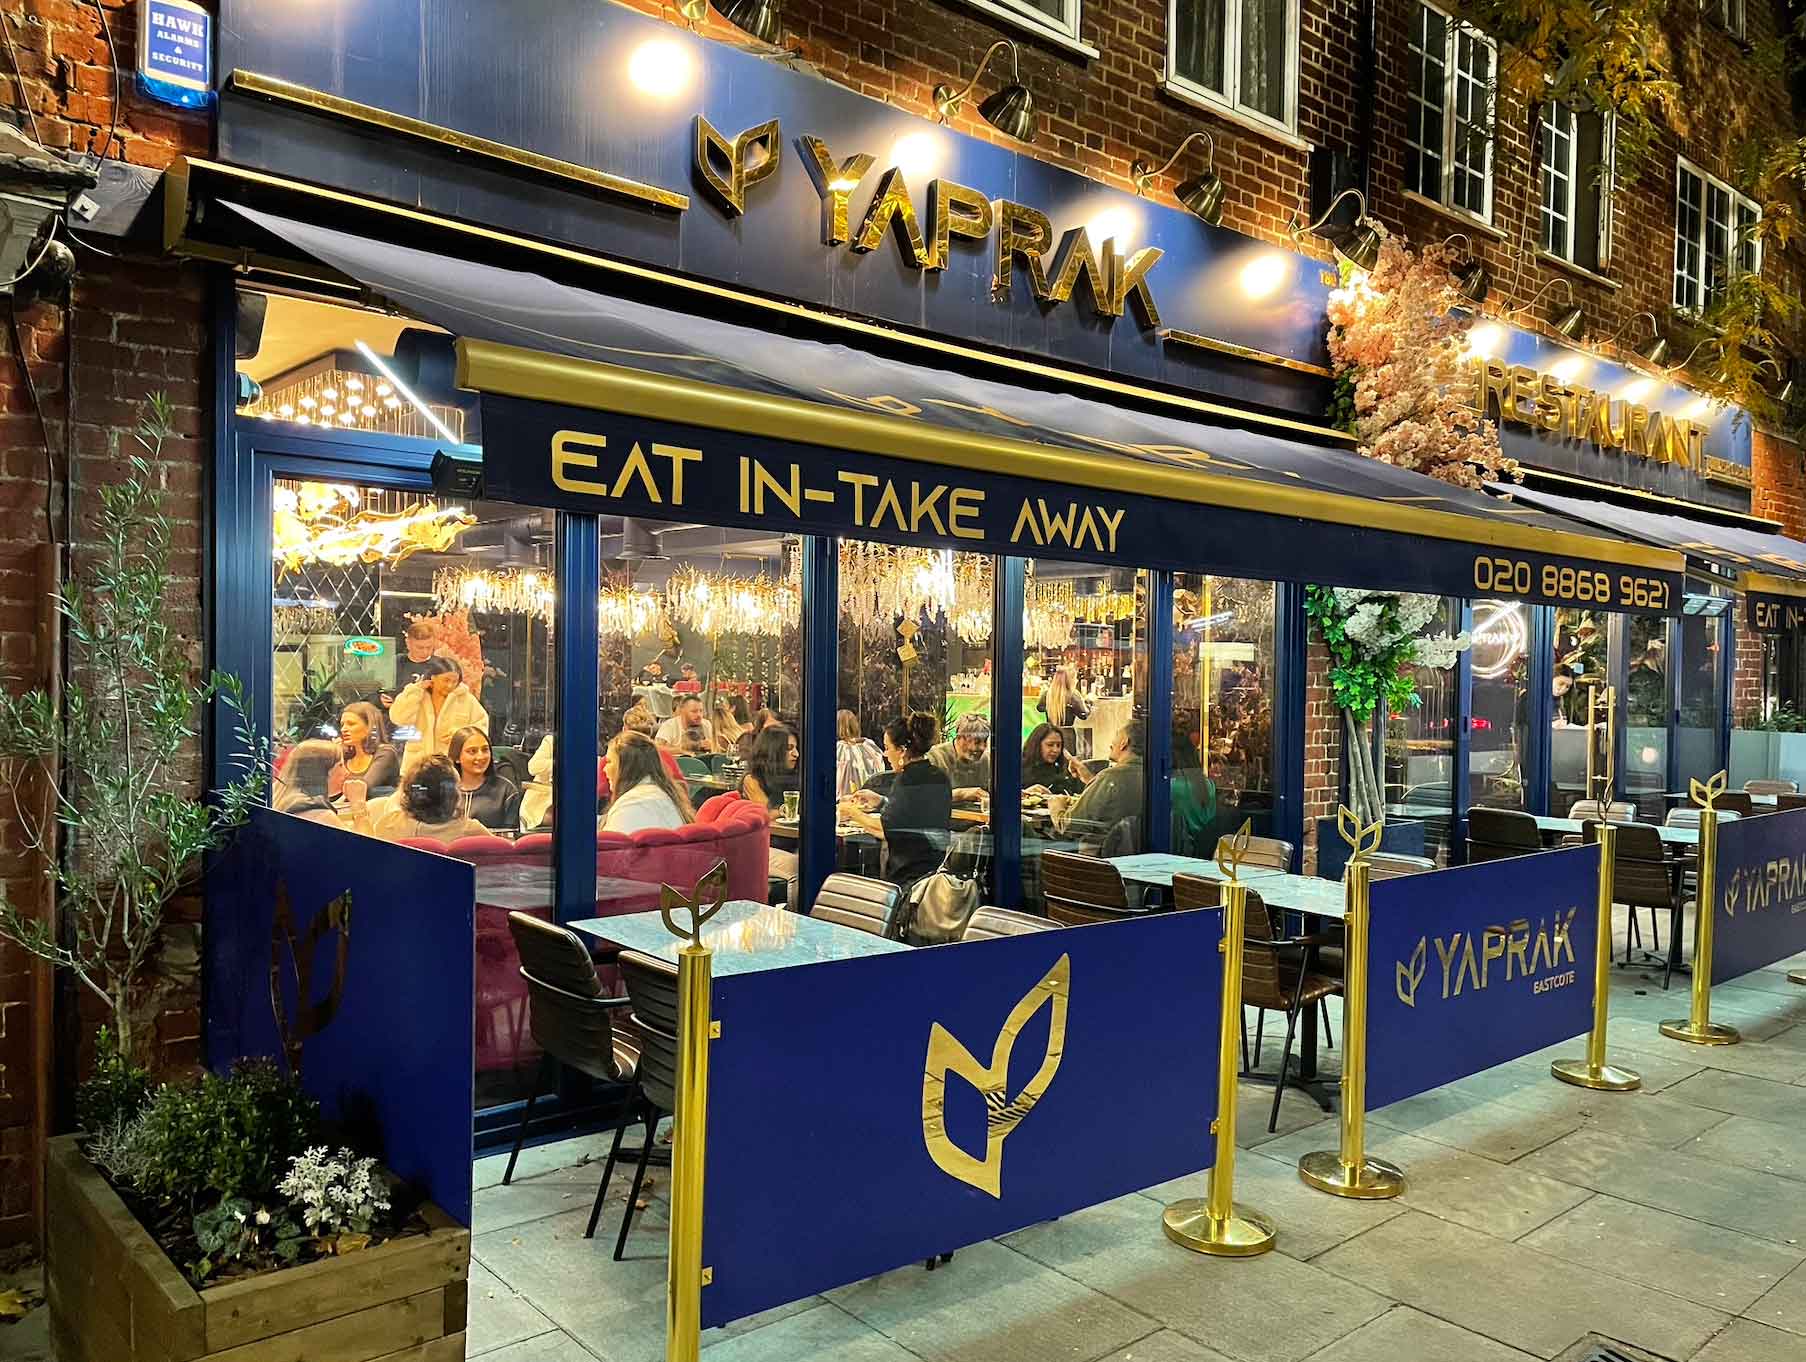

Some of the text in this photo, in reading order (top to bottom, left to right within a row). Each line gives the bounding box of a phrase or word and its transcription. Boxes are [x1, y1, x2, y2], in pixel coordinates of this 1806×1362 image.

[151, 11, 204, 38] HAWK
[156, 29, 200, 49] ALARMS
[151, 51, 204, 72] SECURITY
[793, 134, 1165, 328] YAPRAK
[1478, 356, 1710, 473] RESTAURANT
[551, 429, 703, 505] EAT
[1010, 497, 1126, 553] AWAY
[1474, 556, 1669, 609] 020 8868 9621
[1756, 602, 1781, 628] EAT
[1434, 906, 1577, 999] YAPRAK
[1533, 970, 1576, 995] EASTCOTE
